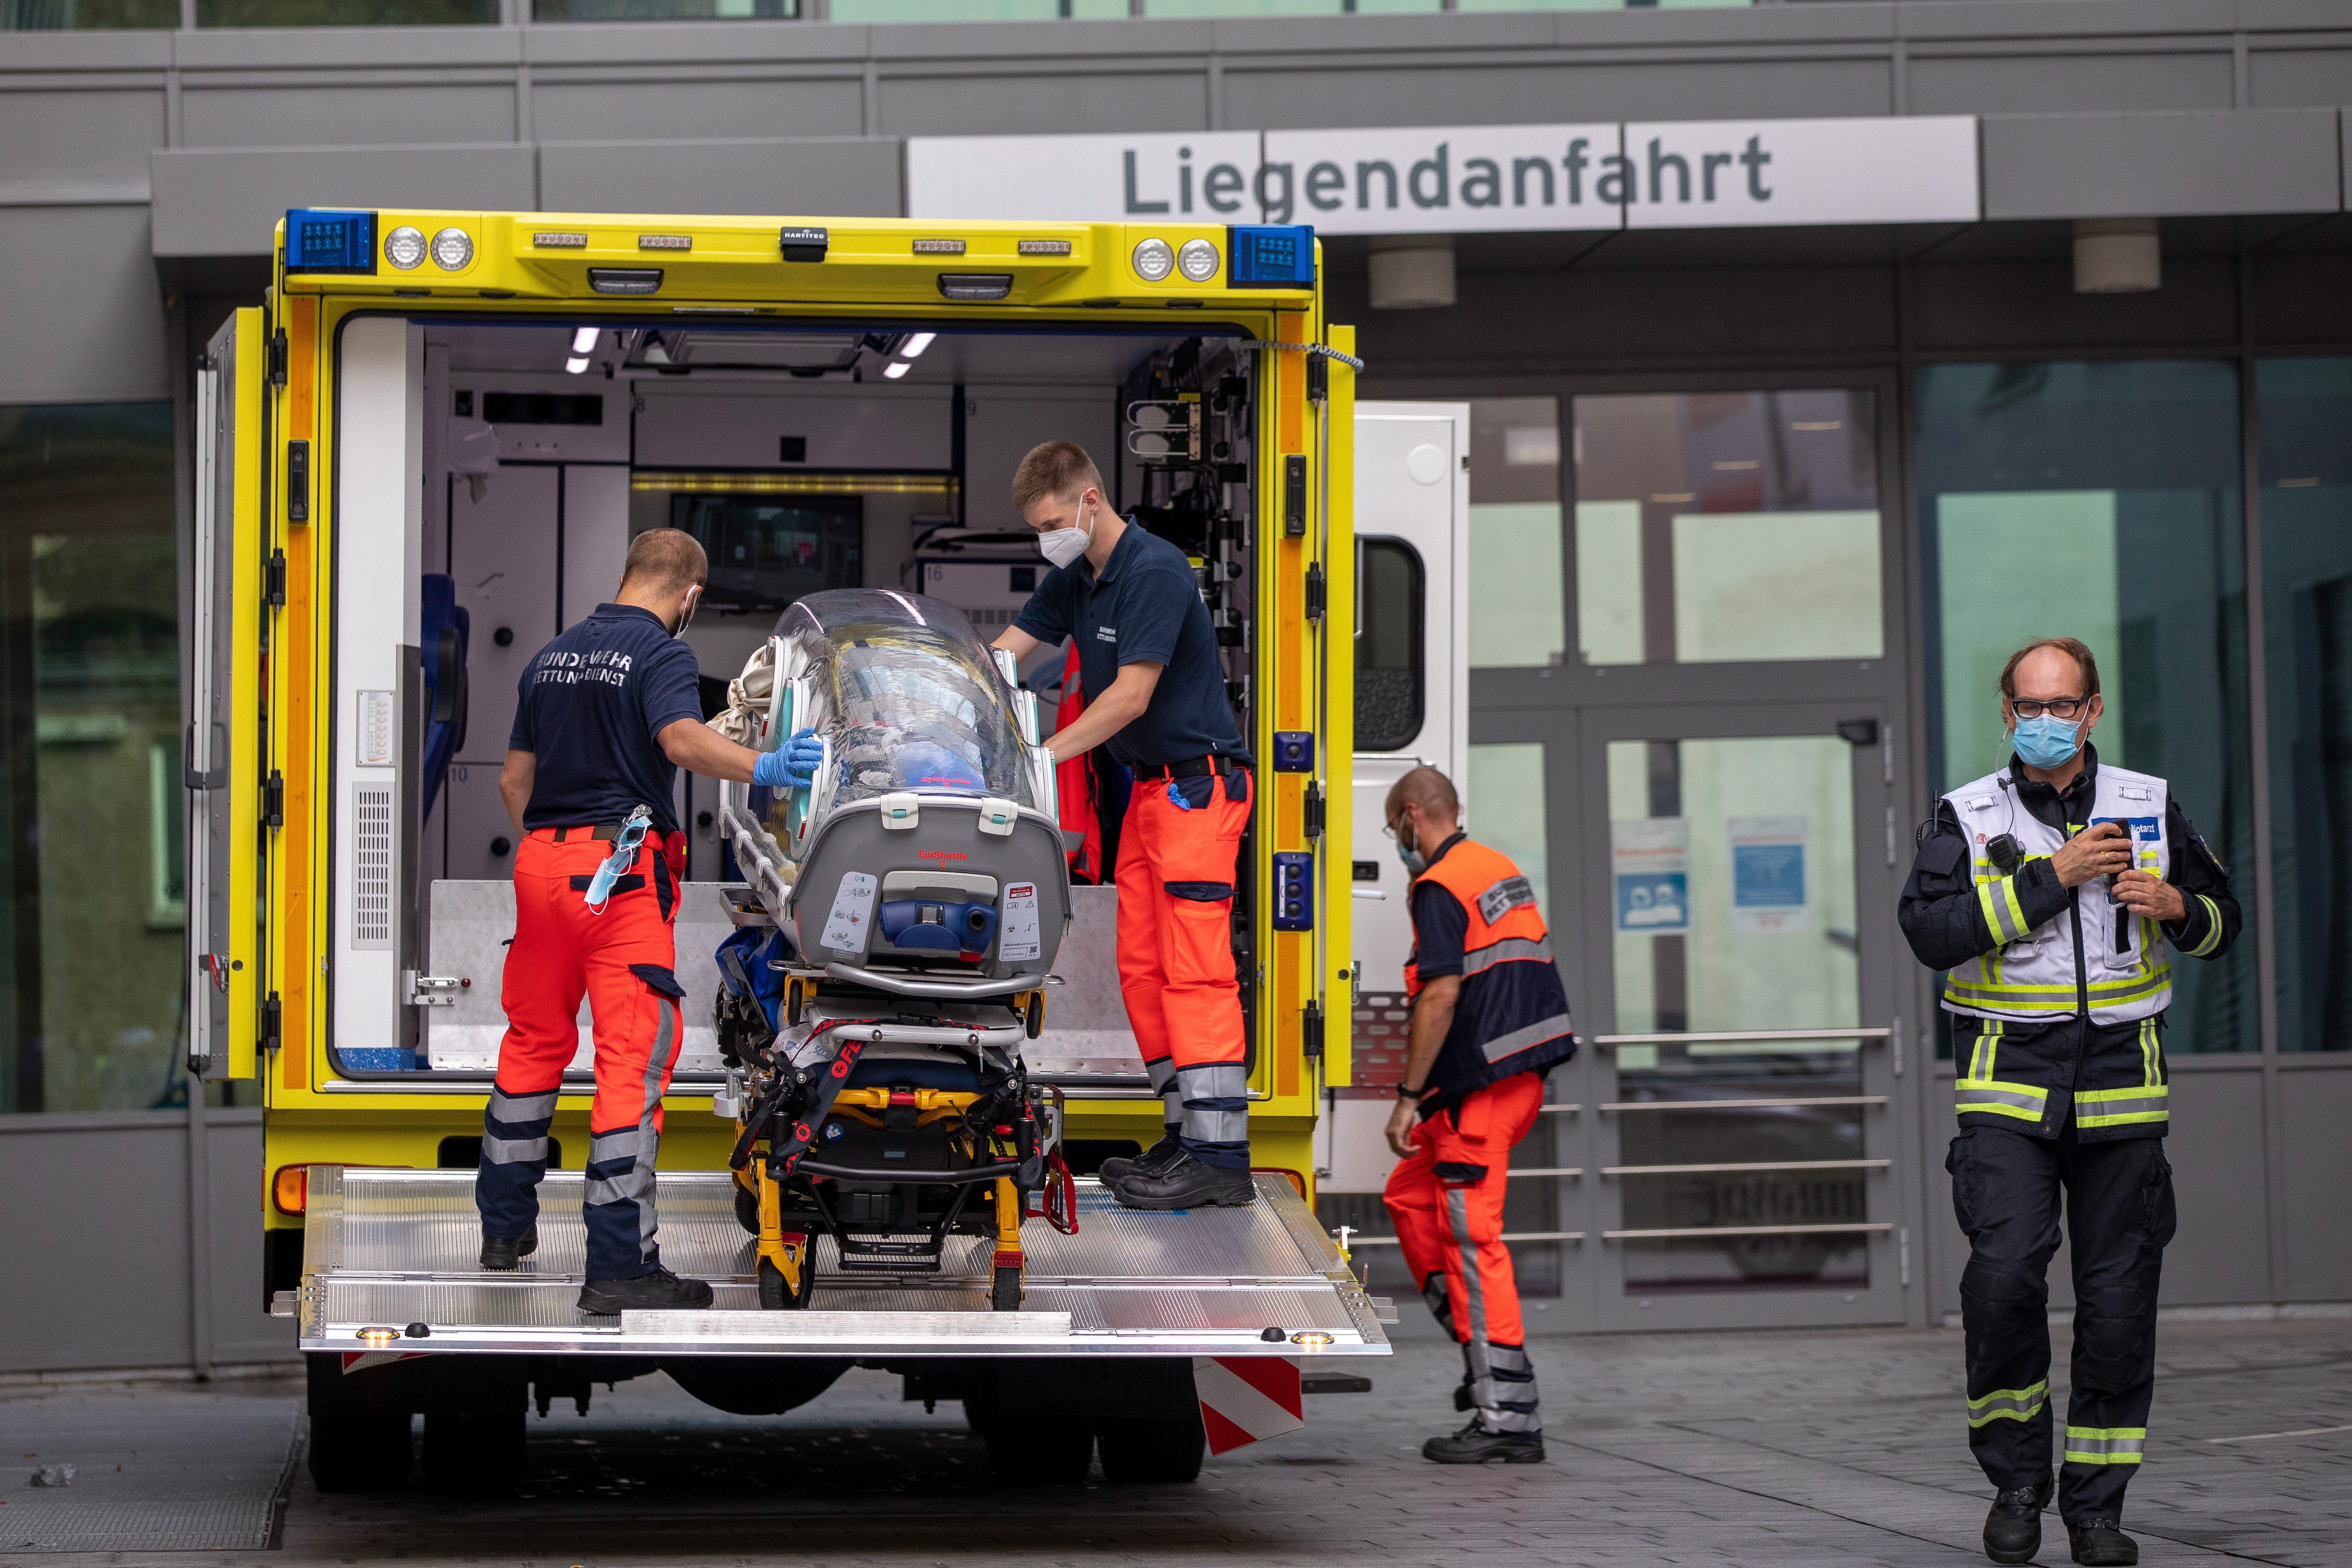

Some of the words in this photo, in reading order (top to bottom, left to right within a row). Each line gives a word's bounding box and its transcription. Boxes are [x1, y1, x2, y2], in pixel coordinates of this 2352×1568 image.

[1123, 136, 1773, 225] Liegendanfahrt
[537, 649, 633, 672] BUNDEWEHR
[919, 850, 968, 860] EpiShuttle
[939, 860, 946, 869] 2
